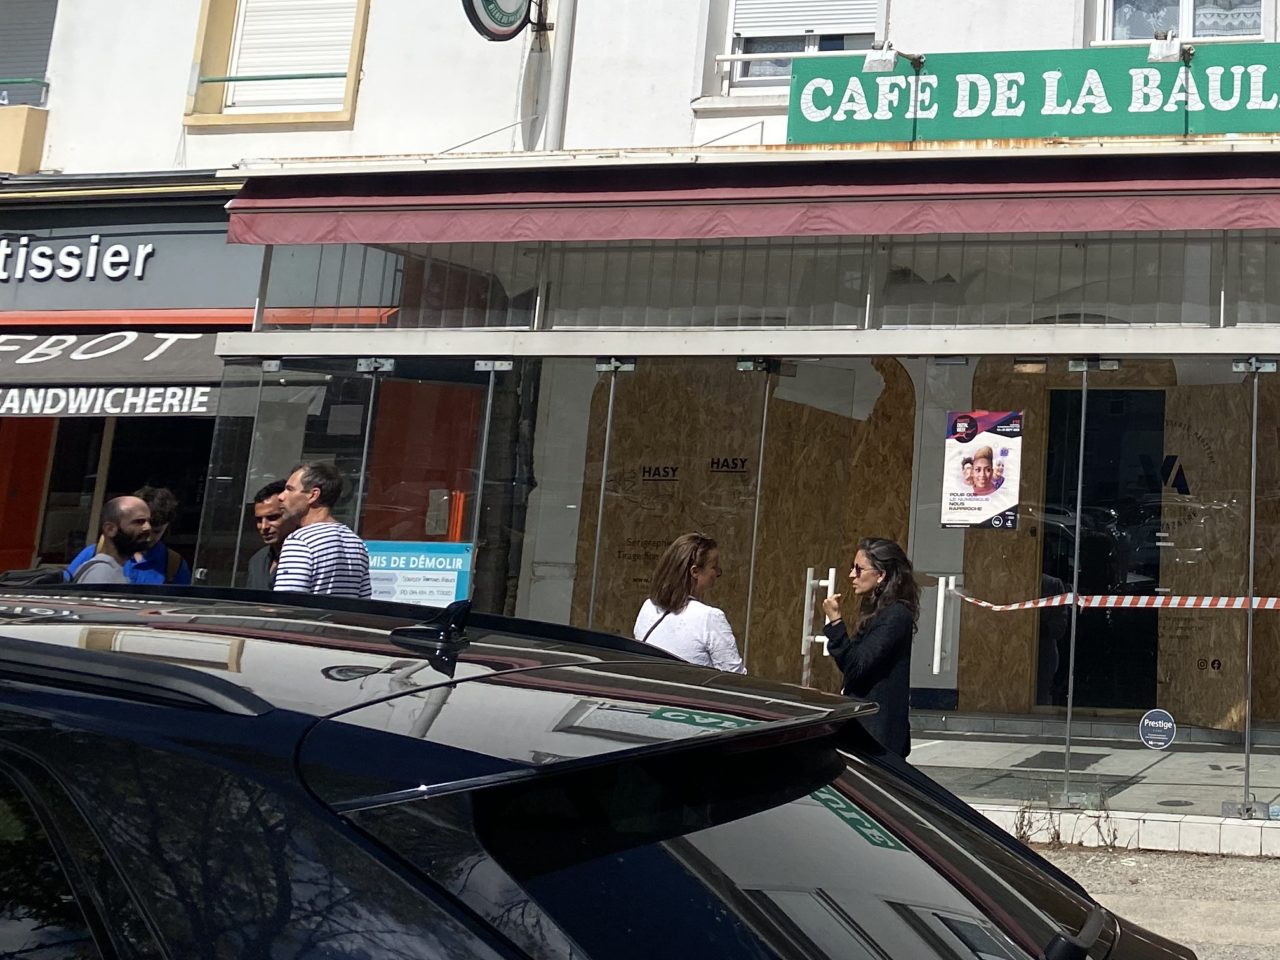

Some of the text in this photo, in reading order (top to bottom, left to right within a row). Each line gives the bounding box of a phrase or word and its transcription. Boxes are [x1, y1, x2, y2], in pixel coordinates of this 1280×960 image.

[799, 73, 940, 123] CAFE
[953, 71, 1027, 118] DE
[1041, 69, 1113, 116] LA
[0, 234, 154, 280] tissier
[0, 387, 211, 414] ANDWICHERIE
[390, 556, 406, 568] DE
[409, 554, 463, 570] DÉMOLIR
[1144, 719, 1173, 730] Prestige
